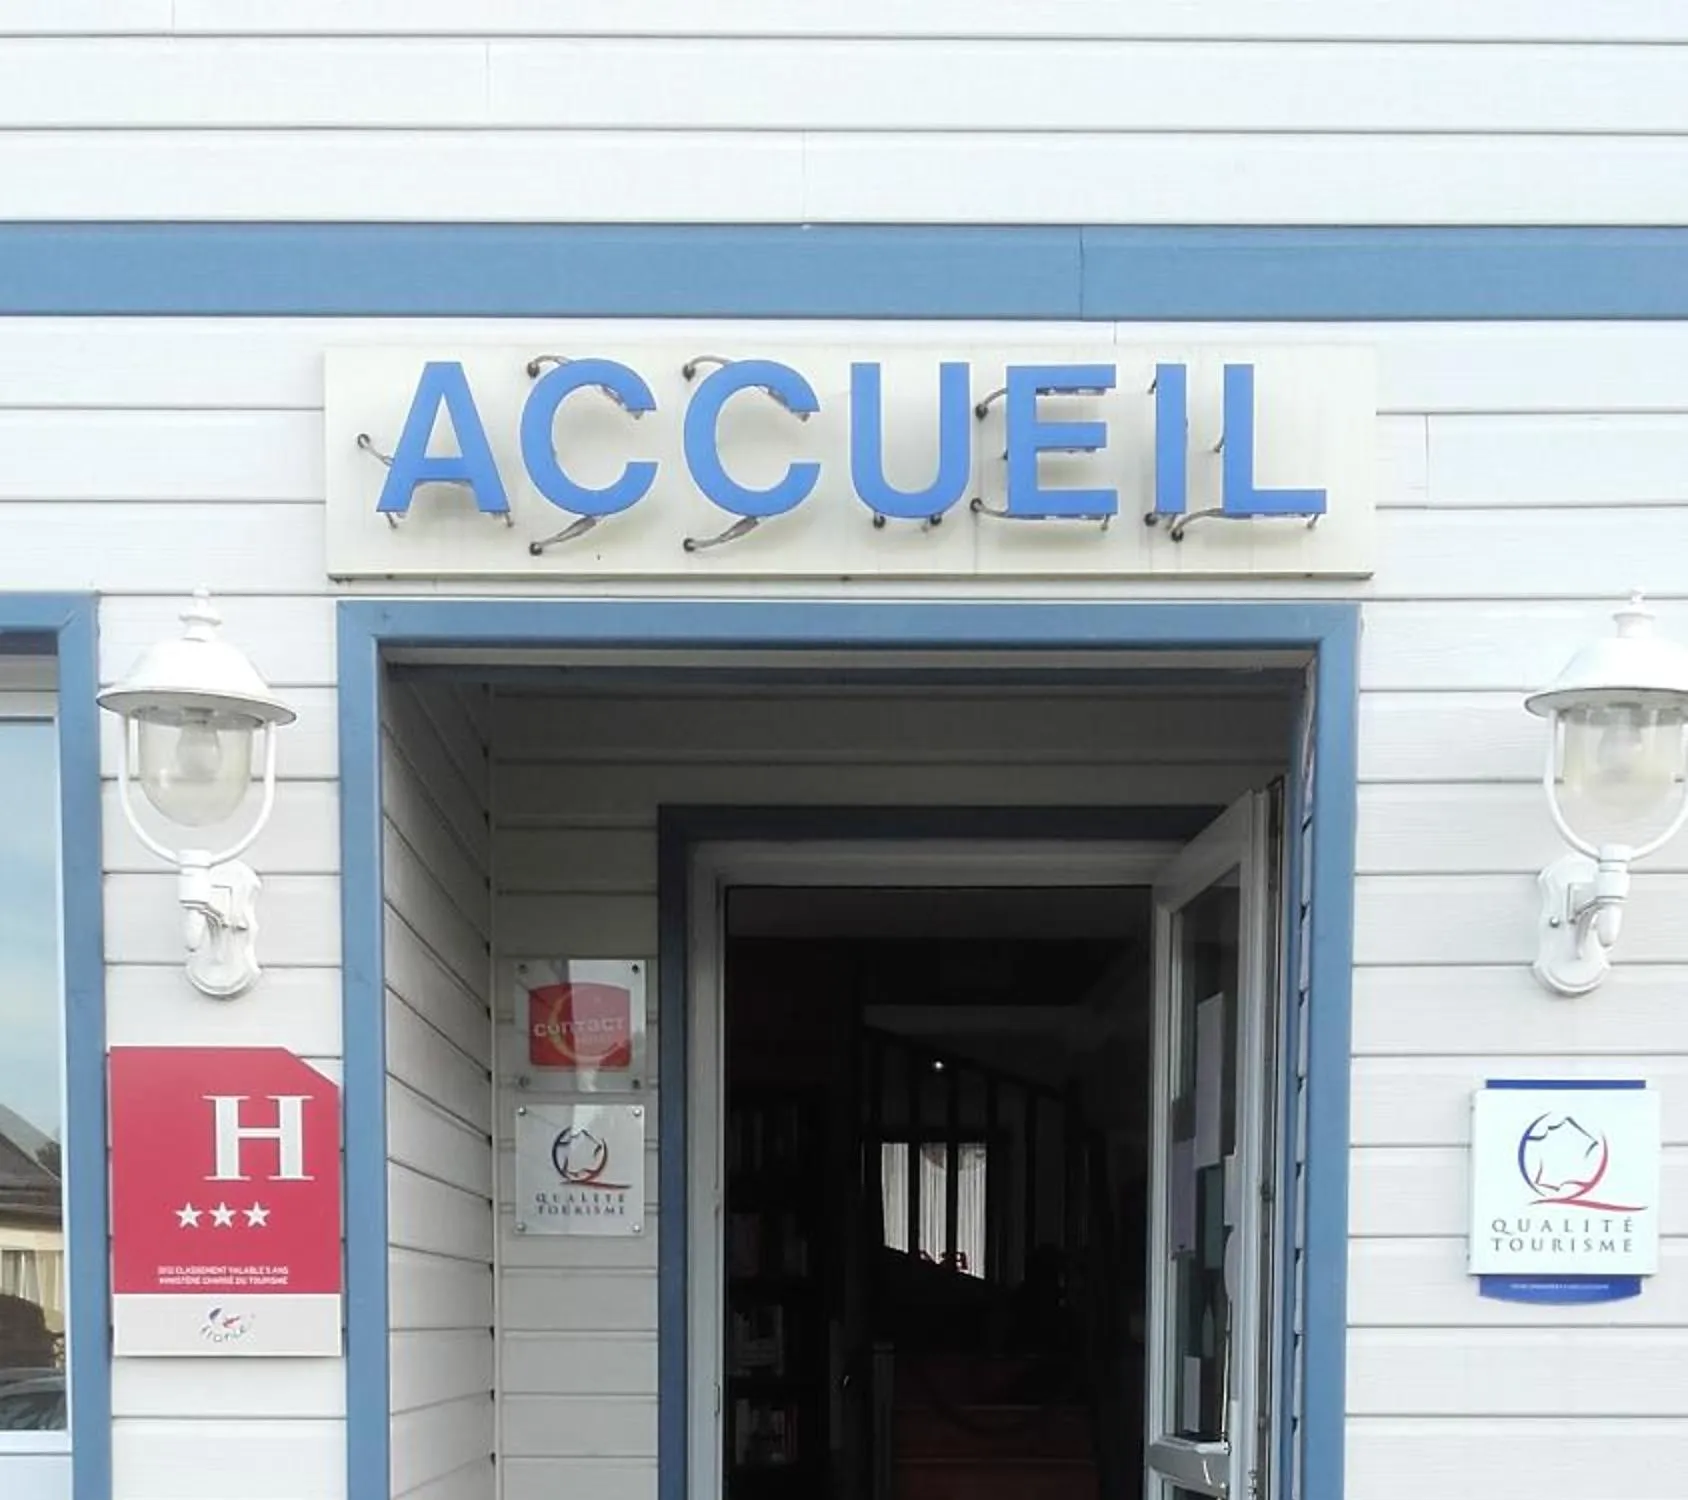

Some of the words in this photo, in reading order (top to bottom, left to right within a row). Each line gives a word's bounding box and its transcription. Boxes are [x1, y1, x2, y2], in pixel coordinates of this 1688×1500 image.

[375, 358, 1327, 519] ACCUEIL
[202, 1095, 315, 1181] H
[1491, 1217, 1634, 1236] QUALITÉ
[1491, 1237, 1633, 1253] TOURISME
